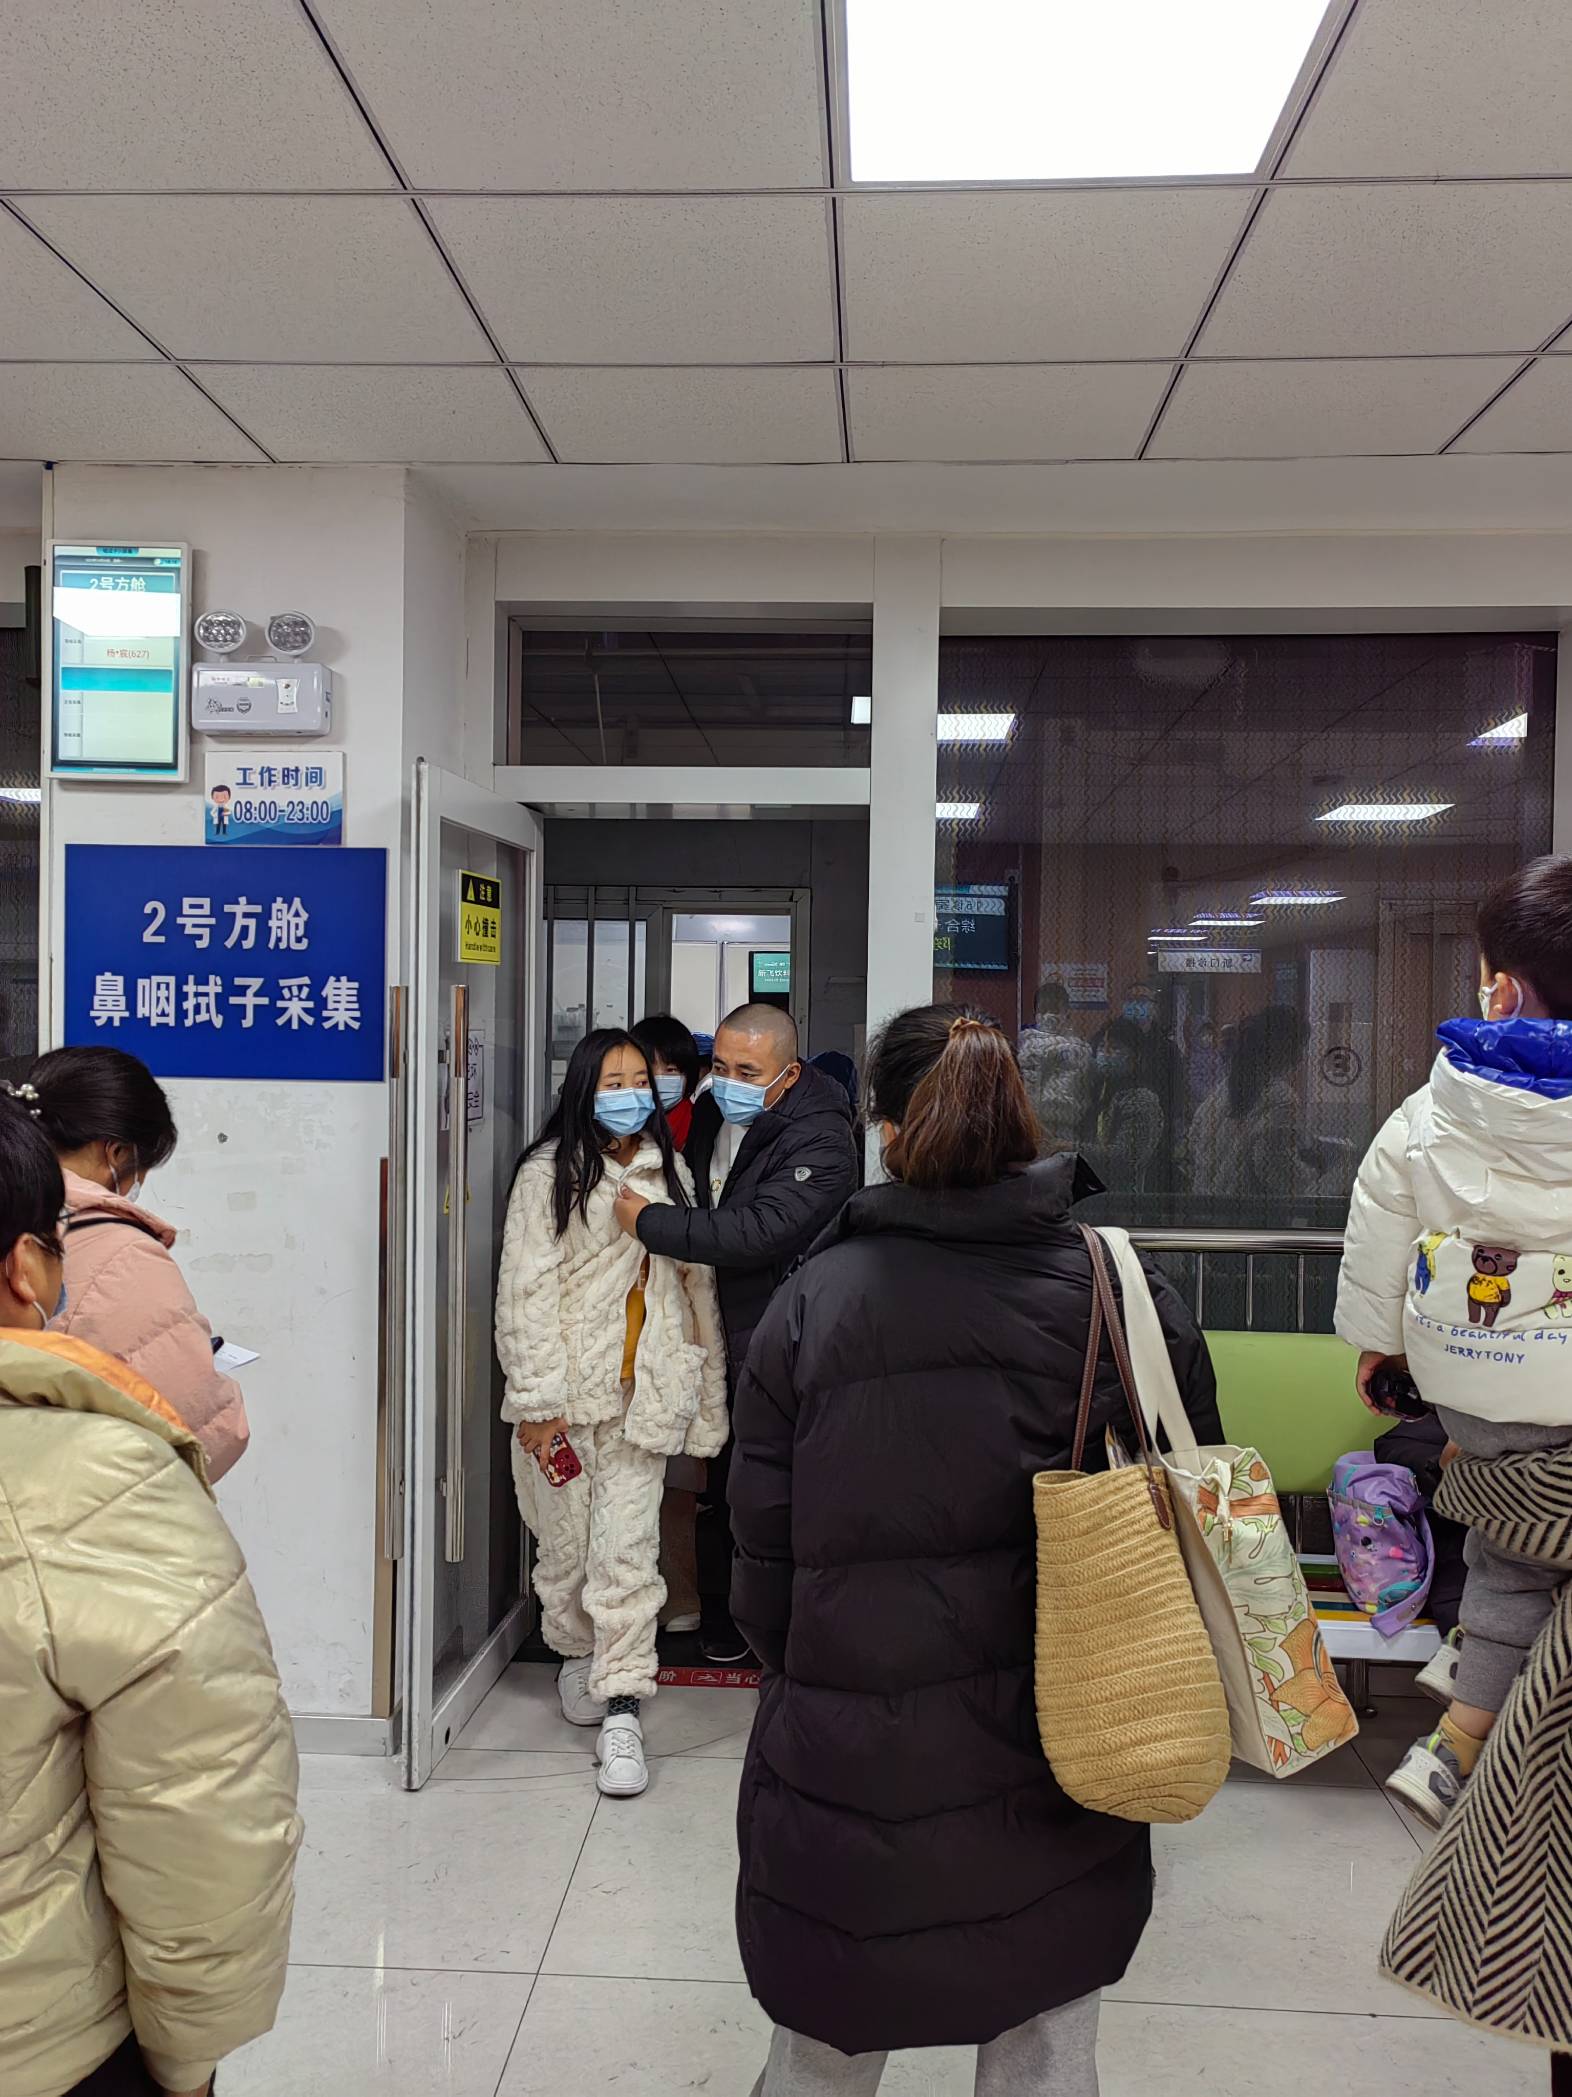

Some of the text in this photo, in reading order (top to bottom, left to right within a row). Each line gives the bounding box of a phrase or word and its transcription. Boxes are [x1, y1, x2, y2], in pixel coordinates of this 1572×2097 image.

[90, 576, 146, 592] 2号方舱
[235, 765, 324, 788] 工作时间
[233, 799, 330, 823] 08:00-23:00
[142, 895, 310, 951] 2号方舱
[89, 971, 362, 1031] 鼻咽拭子采集
[1436, 1325, 1445, 1333] a
[1533, 1330, 1568, 1345] day
[1444, 1344, 1526, 1365] JERRYTONY
[725, 1672, 761, 1685] 当心
